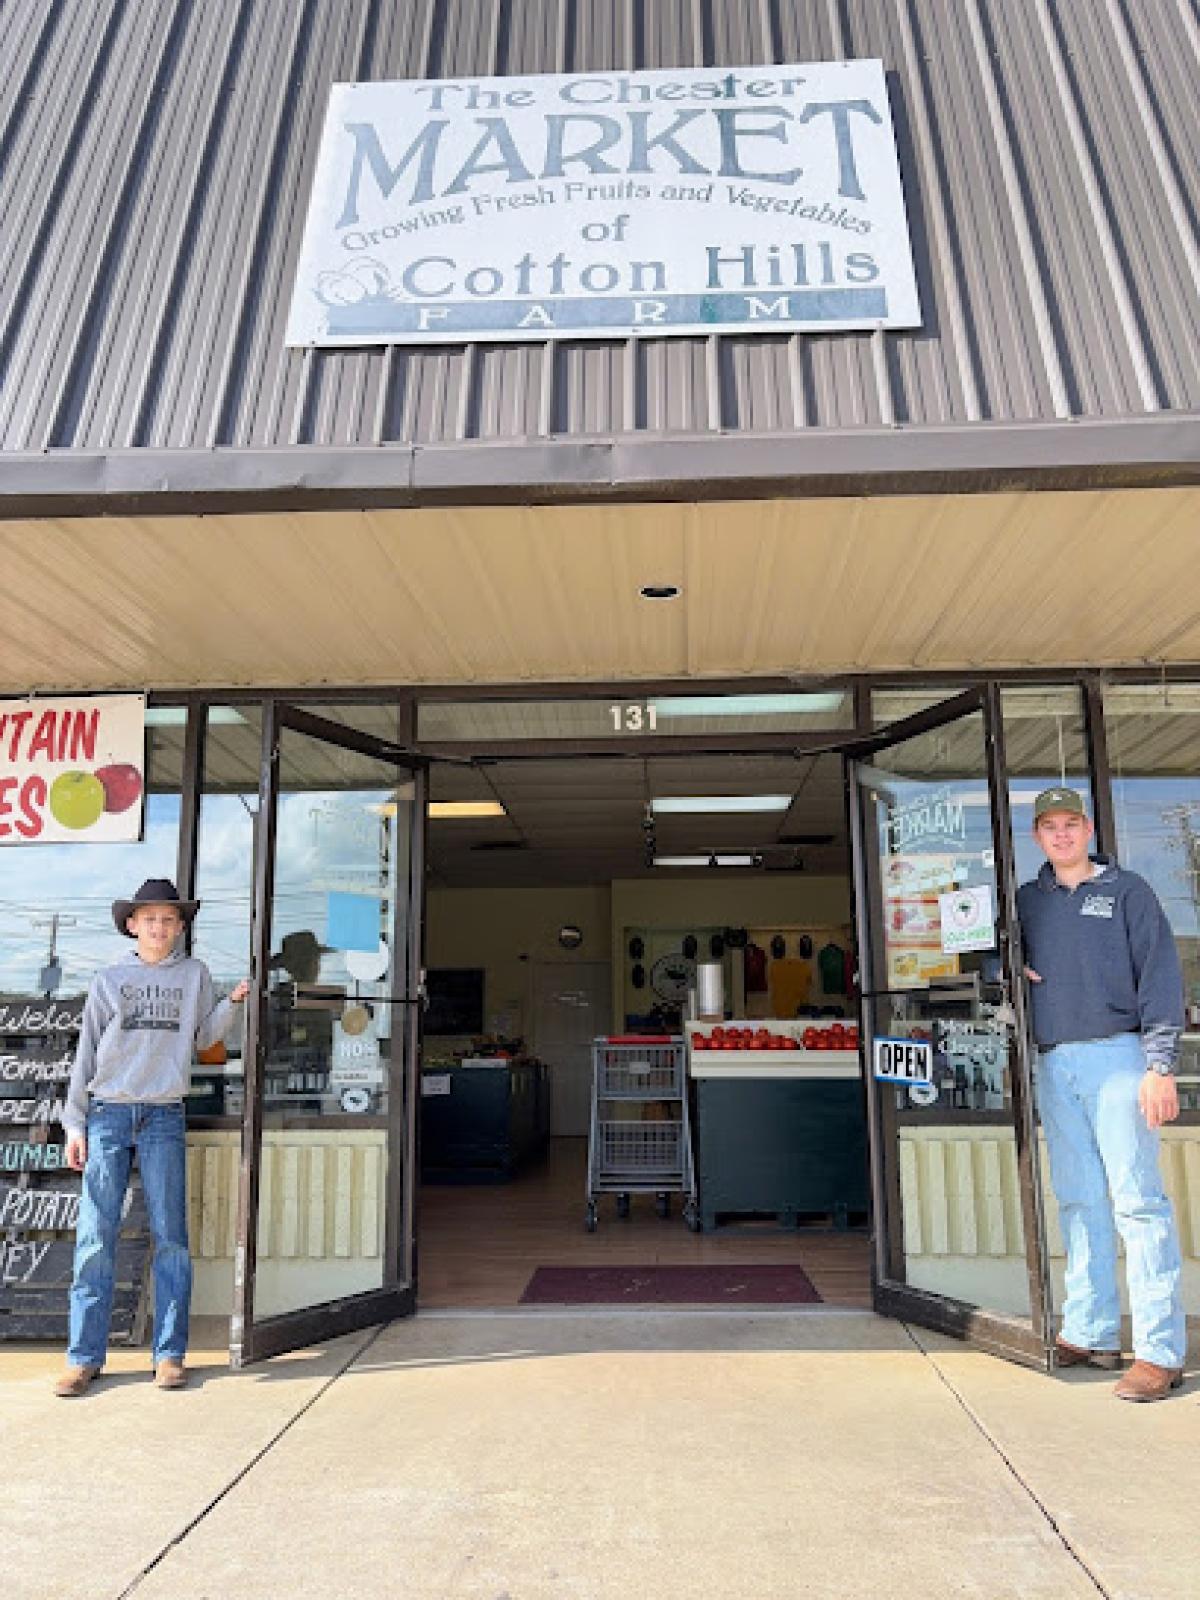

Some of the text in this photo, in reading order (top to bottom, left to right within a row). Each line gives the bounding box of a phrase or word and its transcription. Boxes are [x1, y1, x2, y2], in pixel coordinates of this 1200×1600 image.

[414, 73, 806, 111] The Chester
[334, 99, 883, 230] MARKET
[341, 180, 873, 250] Growing Fresh Fruits and Vegetables
[581, 214, 630, 242] of
[402, 240, 881, 298] Cotton Hills
[417, 296, 792, 331] FARM
[608, 705, 657, 731] 131
[120, 984, 183, 1001] Cotton
[879, 1042, 929, 1080] OPEN
